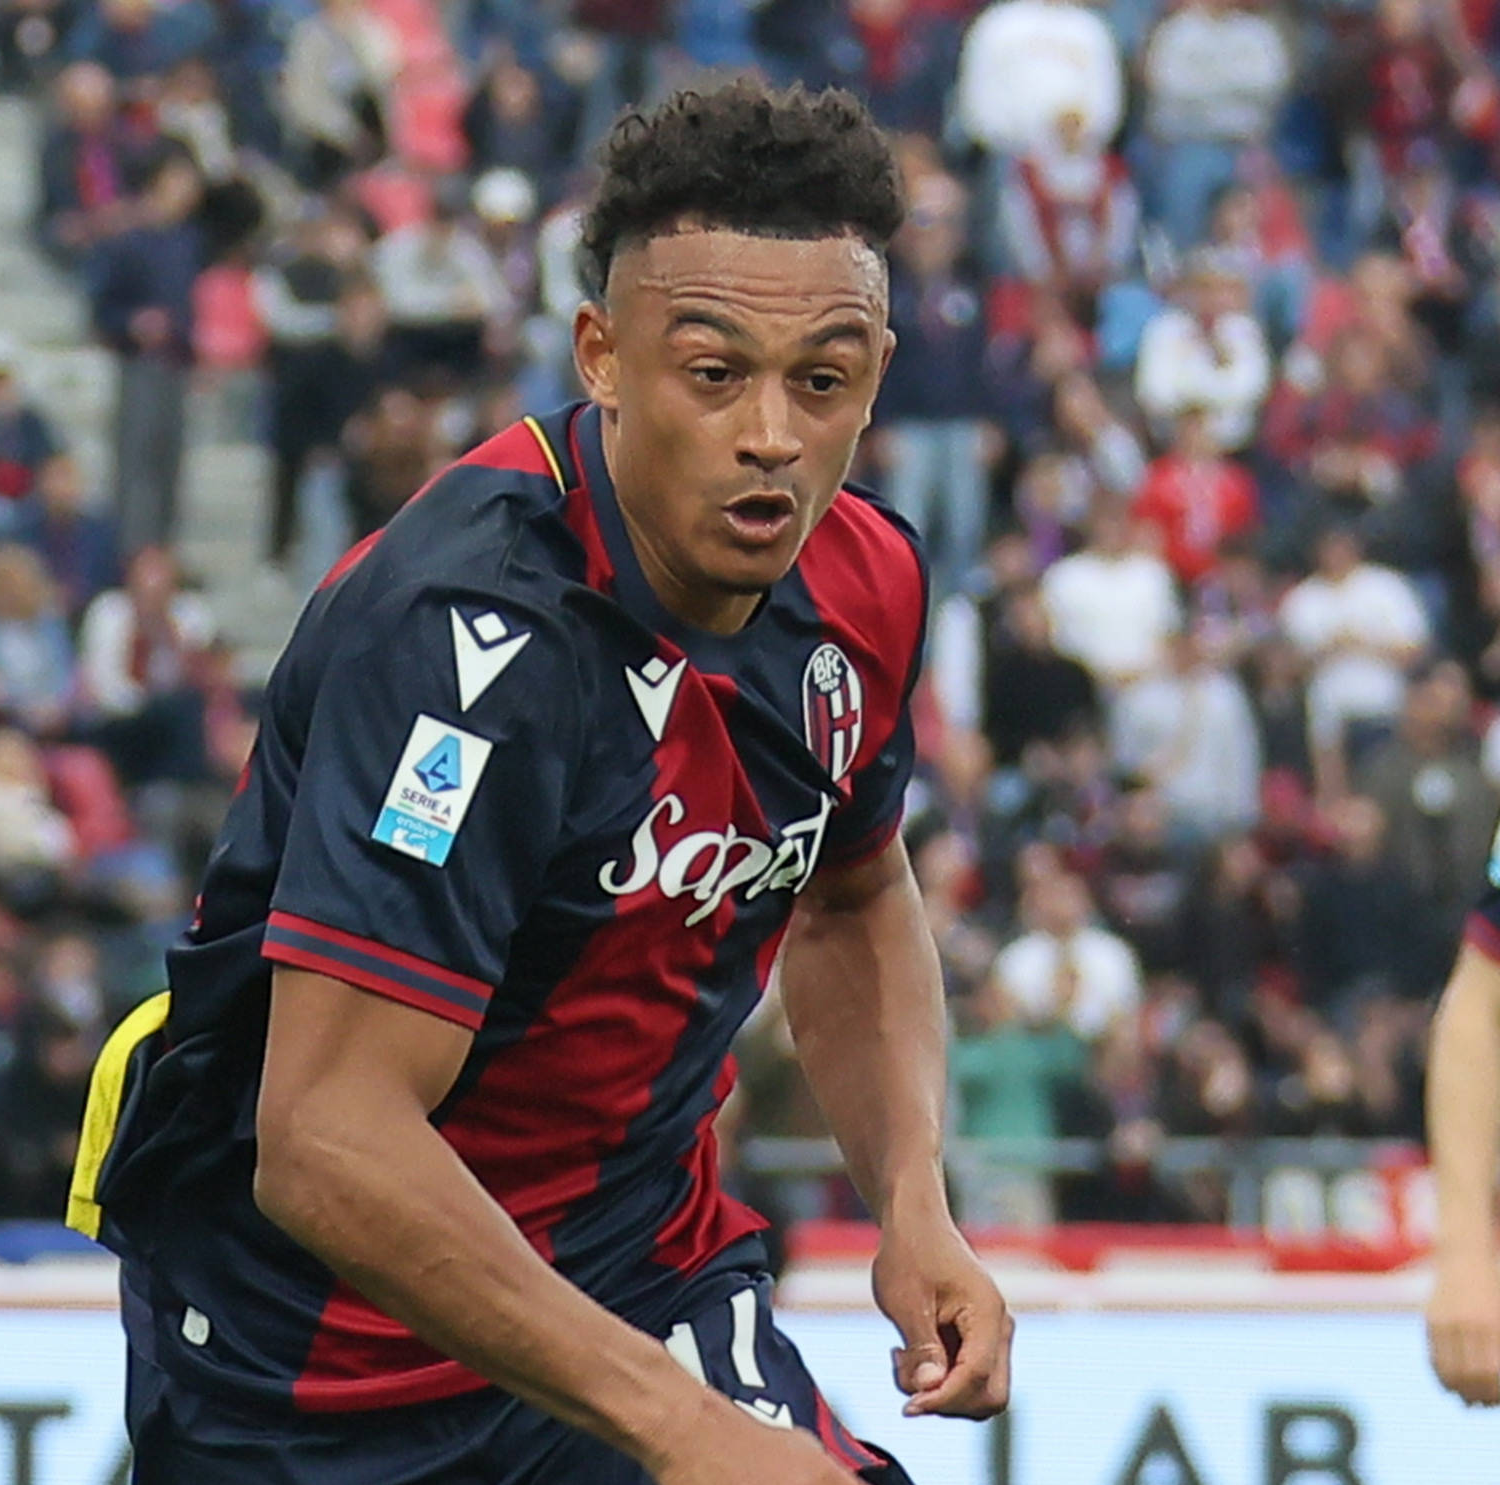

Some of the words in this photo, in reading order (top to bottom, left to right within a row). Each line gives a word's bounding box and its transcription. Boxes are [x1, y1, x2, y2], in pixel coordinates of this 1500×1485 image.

[813, 649, 842, 684] BFC
[400, 786, 441, 812] SERIE
[441, 804, 452, 818] A
[598, 792, 838, 928] Saput
